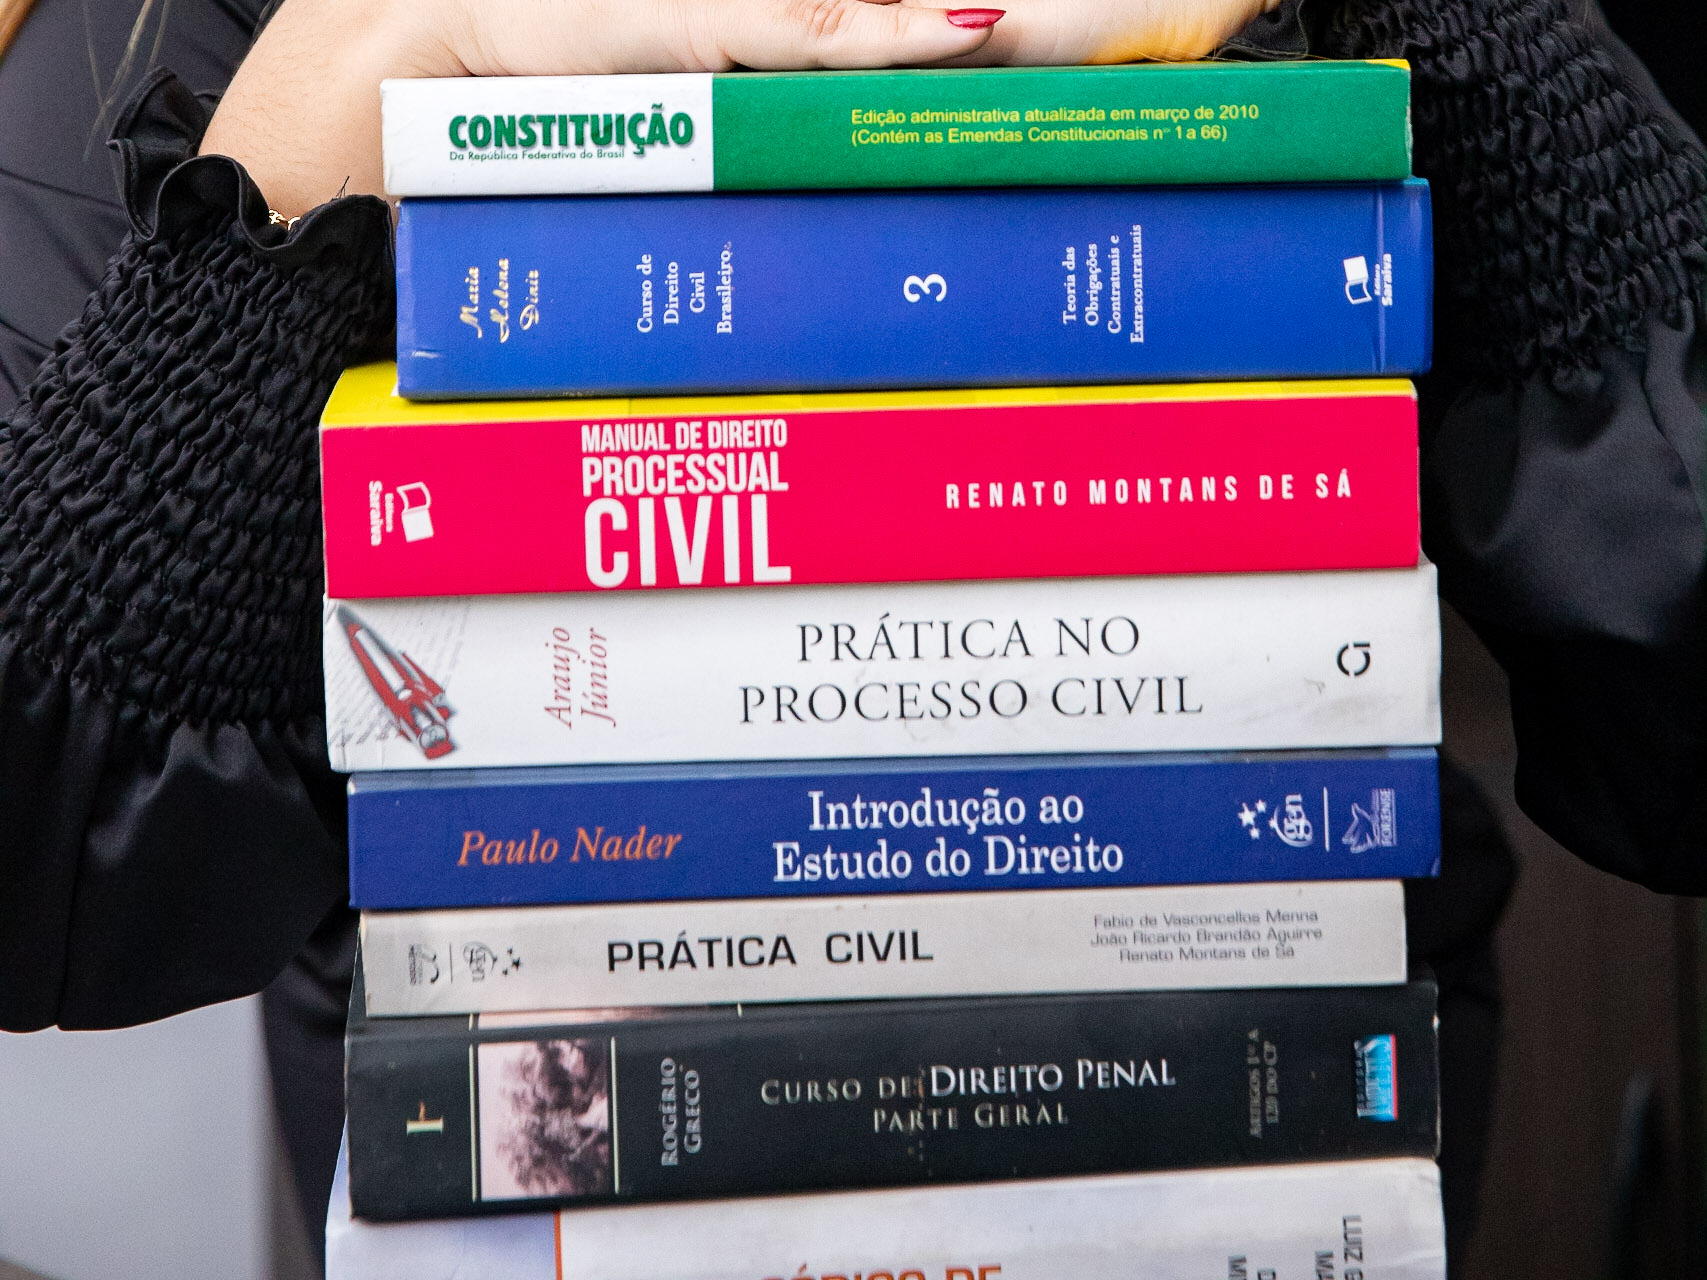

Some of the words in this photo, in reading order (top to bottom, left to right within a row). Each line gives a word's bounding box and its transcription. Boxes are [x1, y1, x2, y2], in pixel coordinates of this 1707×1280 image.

[448, 102, 694, 157] CONSTITUIÇÃO
[851, 109, 906, 127] Edição
[911, 108, 1020, 123] administrativa
[1025, 107, 1106, 122] atualizada
[1110, 109, 1135, 120] em
[1140, 108, 1190, 123] março
[1194, 106, 1214, 120] de
[1219, 104, 1259, 120] 2010
[851, 128, 920, 147] (Contém
[924, 131, 943, 143] as
[948, 128, 1023, 143] Emendas
[1028, 126, 1148, 142] Constitucionais
[1176, 125, 1182, 139] 1
[1186, 128, 1196, 140] a
[1201, 124, 1228, 142] 66)
[449, 151, 465, 161] Da
[468, 150, 518, 162] República
[522, 150, 576, 160] Federativa
[580, 149, 593, 159] do
[597, 148, 625, 159] Brasil
[1061, 246, 1076, 271] das
[1110, 234, 1120, 244] e
[636, 254, 652, 276] de
[903, 273, 947, 303] 3
[1085, 243, 1103, 326] Obrigações
[1130, 224, 1144, 343] Extracontratuais
[459, 267, 482, 339] Maria
[637, 279, 653, 333] Curso
[663, 261, 679, 325] Direito
[689, 271, 705, 314] Civil
[716, 248, 733, 334] Brasileiro
[1062, 274, 1077, 325] Teoria
[1107, 247, 1121, 334] Contratuais
[581, 422, 671, 453] MANUAL
[675, 421, 703, 450] DE
[707, 418, 788, 450] DIREITO
[582, 451, 789, 497] PROCESSUAL
[945, 480, 1068, 509] RENATO
[1088, 475, 1237, 506] MONTANS
[1259, 474, 1295, 500] DE
[1315, 468, 1352, 499] SÁ
[584, 493, 792, 589] CIVIL
[797, 612, 1035, 663] PRÁTICA
[1053, 615, 1141, 658] NO
[543, 626, 580, 730] Araujo
[581, 626, 617, 729] Júnior
[738, 679, 1029, 724] PROCESSO
[1051, 676, 1204, 717] CIVIL
[807, 786, 1026, 834] Introdução
[1039, 793, 1084, 824] ao
[456, 829, 559, 867] Paulo
[569, 825, 682, 863] Nader
[772, 837, 913, 883] Estudo
[925, 835, 972, 878] do
[984, 832, 1124, 876] Direito
[1090, 931, 1127, 947] João
[1133, 929, 1191, 945] Ricardo
[1196, 927, 1261, 943] Brandão
[1267, 927, 1323, 945] Aguirre
[1093, 913, 1134, 929] Fabio
[1139, 913, 1157, 927] de
[1163, 910, 1260, 927] Vasconcellos
[1266, 908, 1318, 924] Menna
[606, 929, 798, 972] PRÁTICA
[825, 927, 934, 964] CIVIL
[1119, 947, 1174, 963] Renato
[1178, 945, 1246, 961] Montans
[1251, 945, 1270, 959] de
[761, 1078, 862, 1105] CURSO
[879, 1075, 912, 1100] DE
[930, 1063, 1064, 1098] DIREITO
[1077, 1057, 1176, 1090] PENAL
[659, 1056, 678, 1166] ROGÉRIO
[684, 1069, 702, 1154] GRECO
[874, 1106, 958, 1134] PARTE
[974, 1101, 1069, 1128] GERAL
